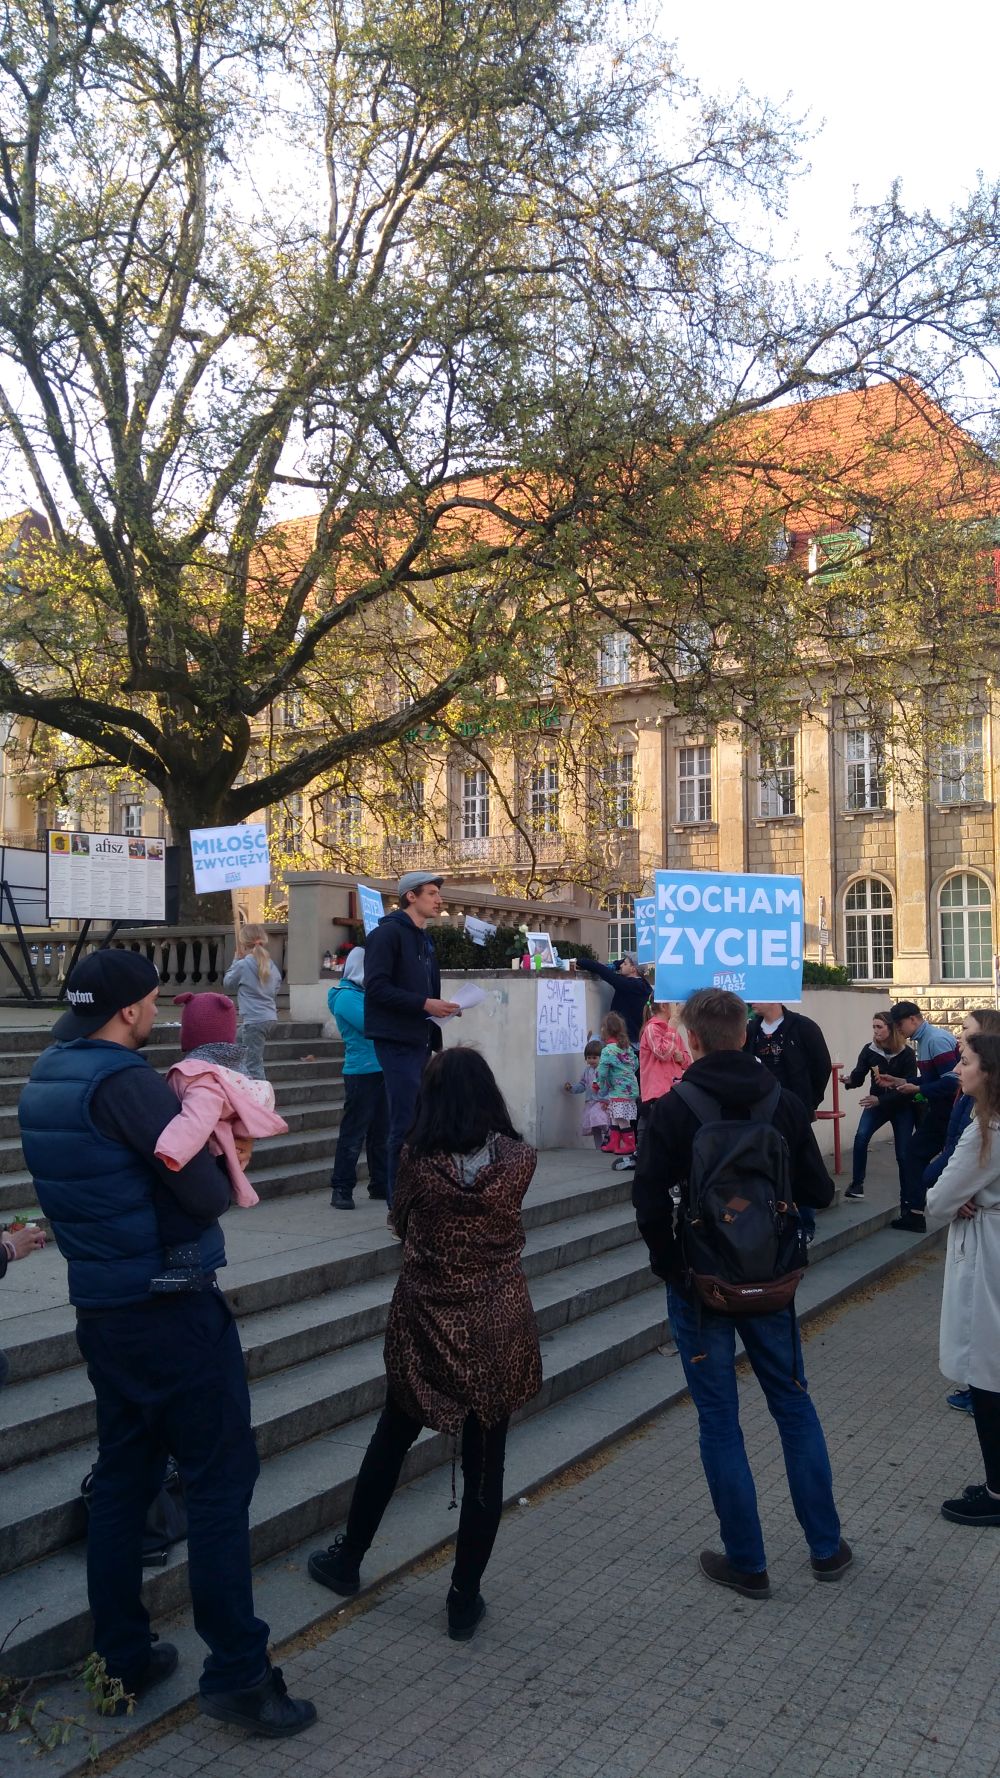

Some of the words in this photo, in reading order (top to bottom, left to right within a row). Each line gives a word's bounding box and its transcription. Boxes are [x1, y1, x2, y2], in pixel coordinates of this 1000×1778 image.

[96, 838, 124, 854] afisz
[192, 829, 267, 856] MIŁOŚĆ
[194, 850, 269, 871] ZWYCIĘŻY!
[657, 884, 800, 915] KOCHAM
[657, 913, 801, 971] ŻYCIE!
[546, 979, 574, 1003] SAVE
[713, 972, 746, 987] BIAŁY
